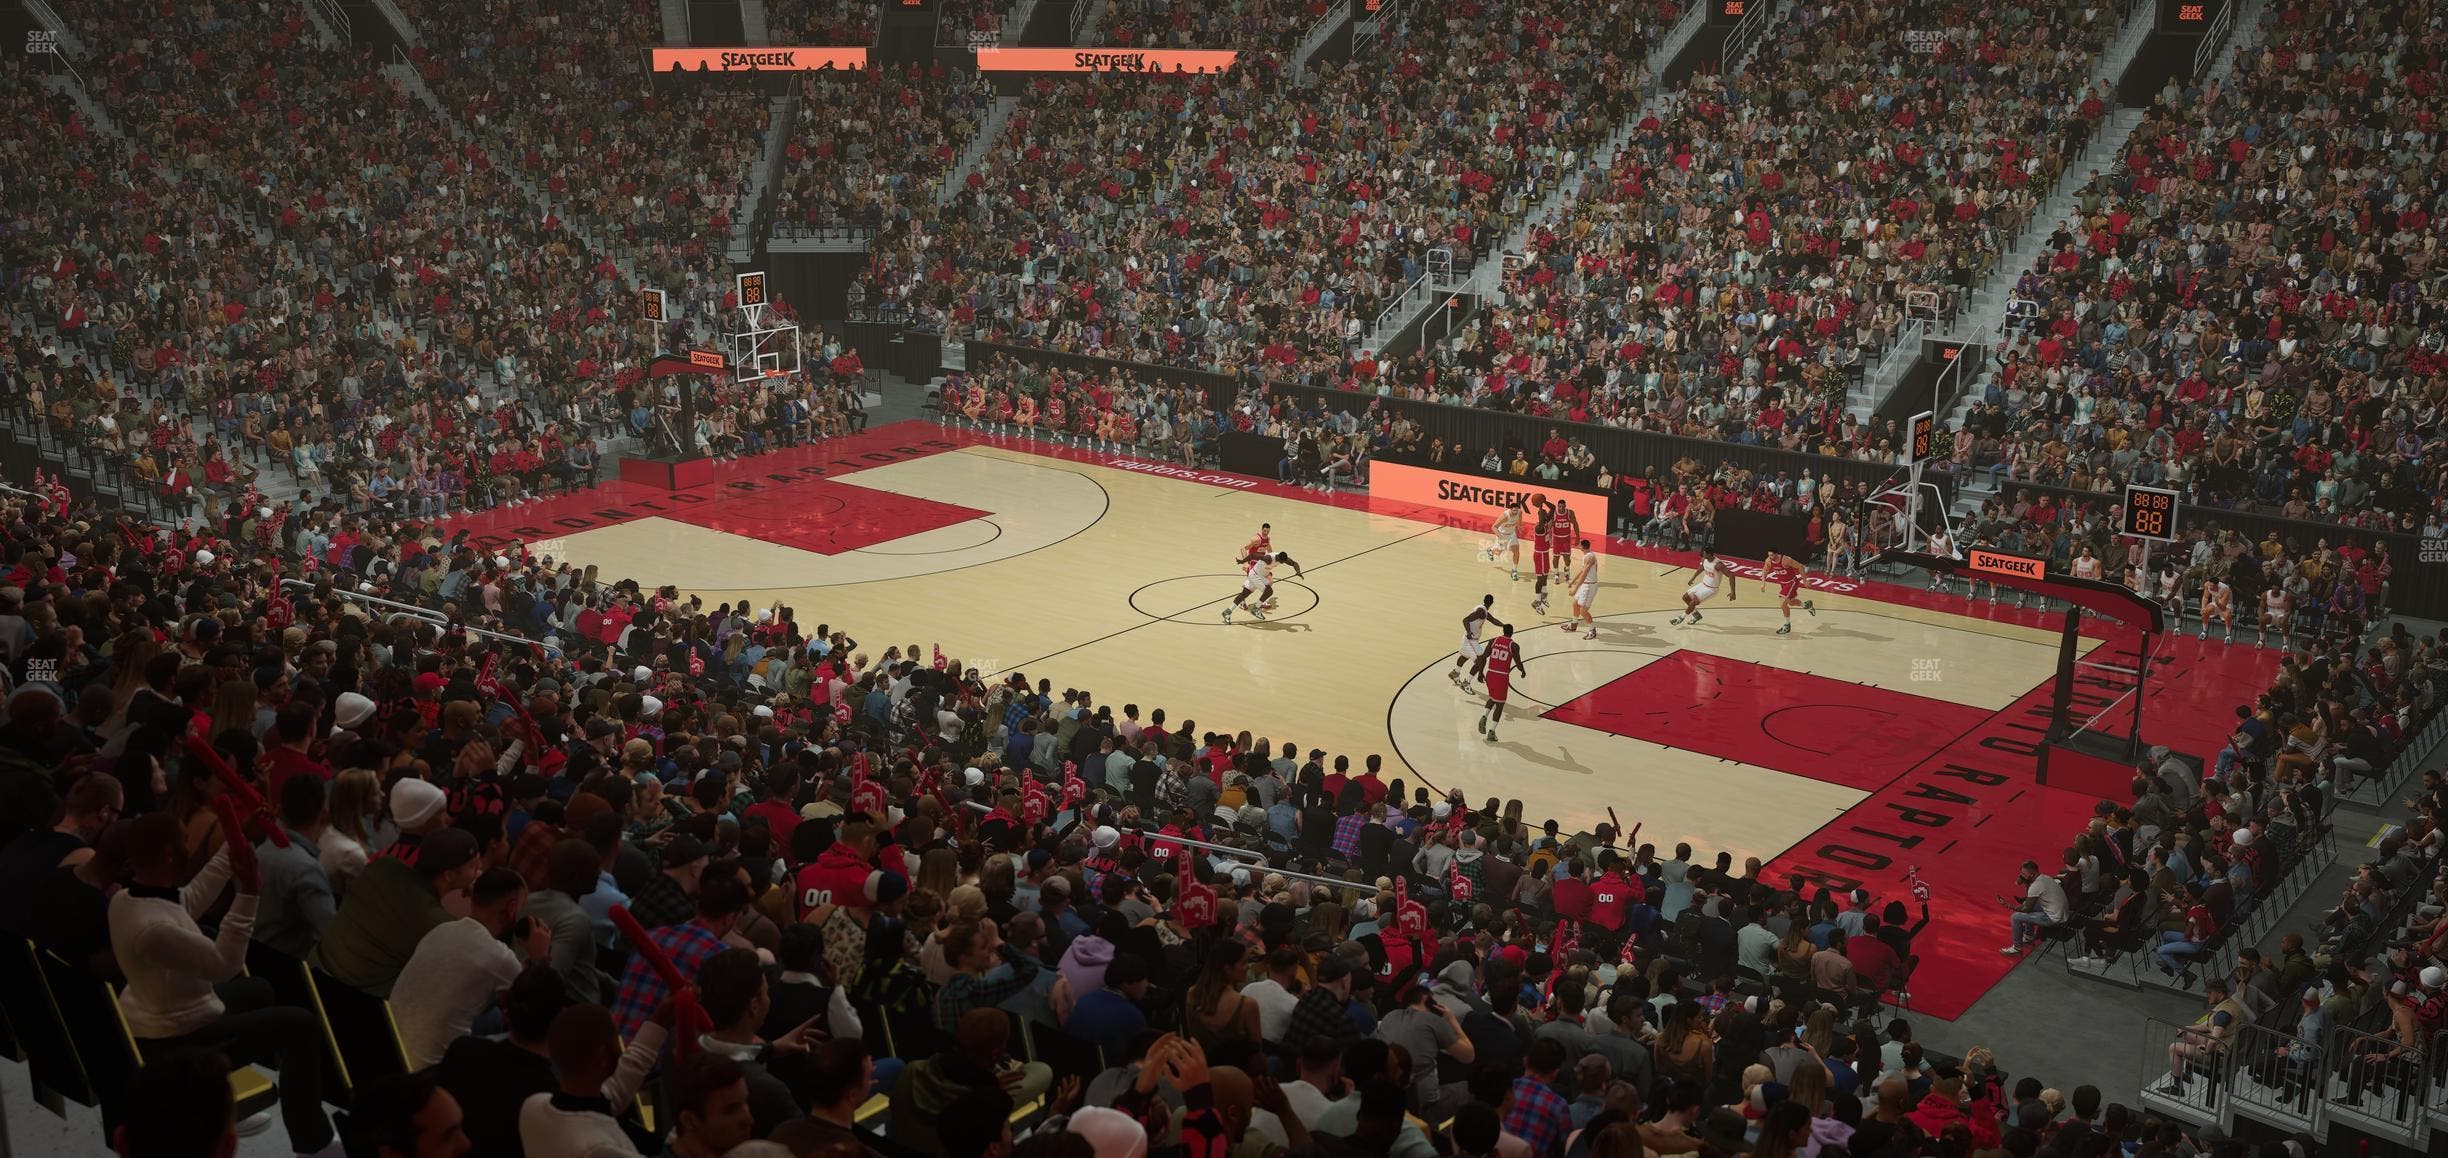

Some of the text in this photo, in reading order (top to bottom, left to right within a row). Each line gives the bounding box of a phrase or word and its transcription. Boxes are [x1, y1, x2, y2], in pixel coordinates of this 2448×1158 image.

[2179, 12, 2203, 20] GEEK
[721, 51, 795, 67] SEATGEEK
[693, 353, 720, 366] SEATGEEK
[1108, 459, 1259, 489] raptors.com
[468, 439, 957, 547] ORONTO RAPTORS
[1438, 479, 1532, 514] SEATGEEK
[2135, 509, 2163, 534] 88
[1977, 554, 2036, 576] SEATGEEK
[1491, 647, 1510, 662] 00
[1778, 763, 2011, 894] RAPTOR
[1154, 847, 1169, 857] 00
[804, 888, 822, 907] 00
[1598, 893, 1614, 903] 00
